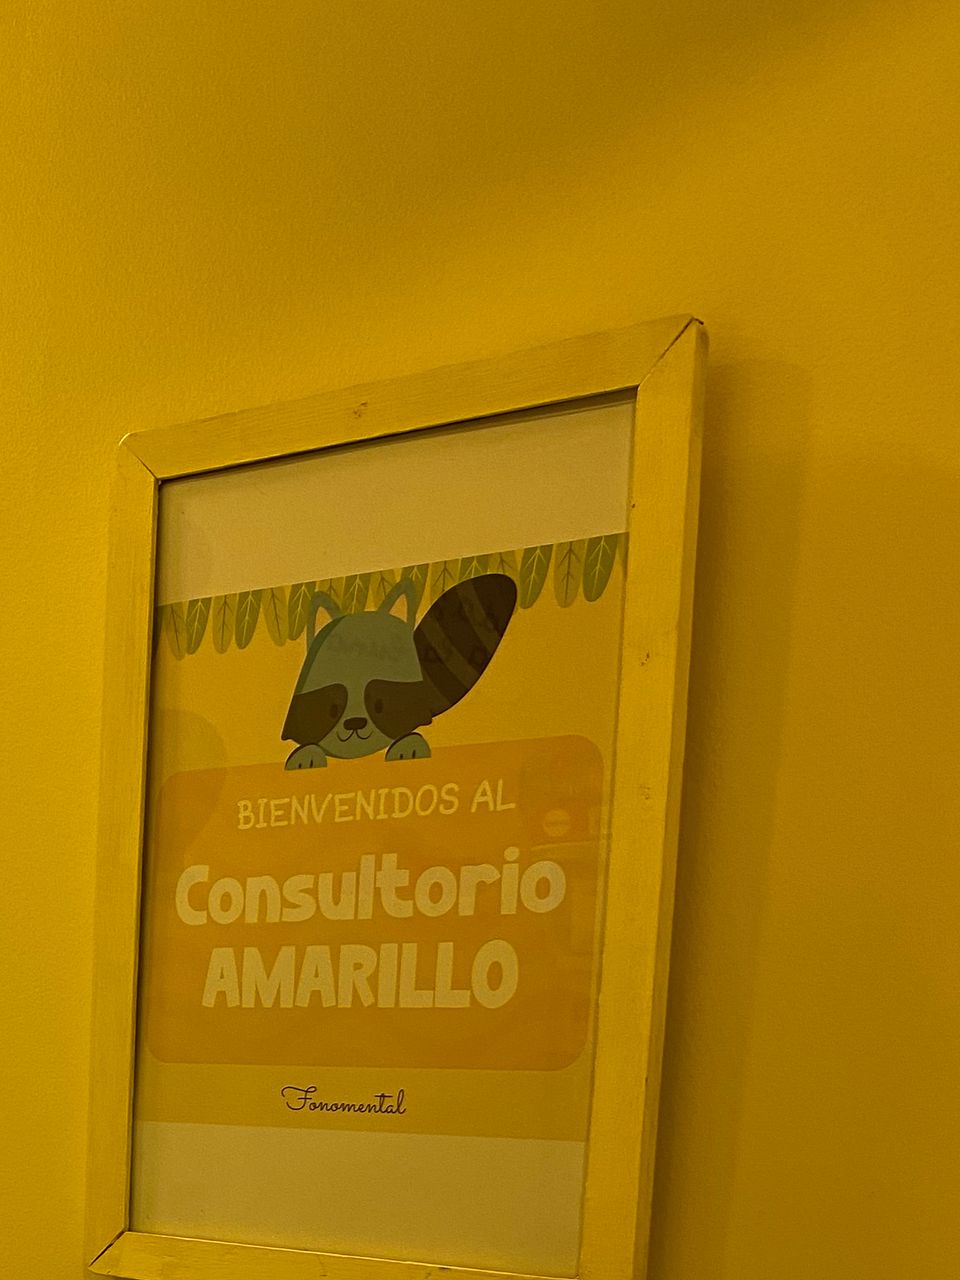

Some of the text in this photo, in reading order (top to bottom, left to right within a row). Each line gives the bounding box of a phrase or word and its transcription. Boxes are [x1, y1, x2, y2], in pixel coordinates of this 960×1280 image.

[237, 779, 516, 830] BIENVENIDOS AL
[175, 846, 566, 926] Consultorio
[201, 939, 519, 1009] AMARILLO
[281, 1085, 407, 1116] Fonomental
